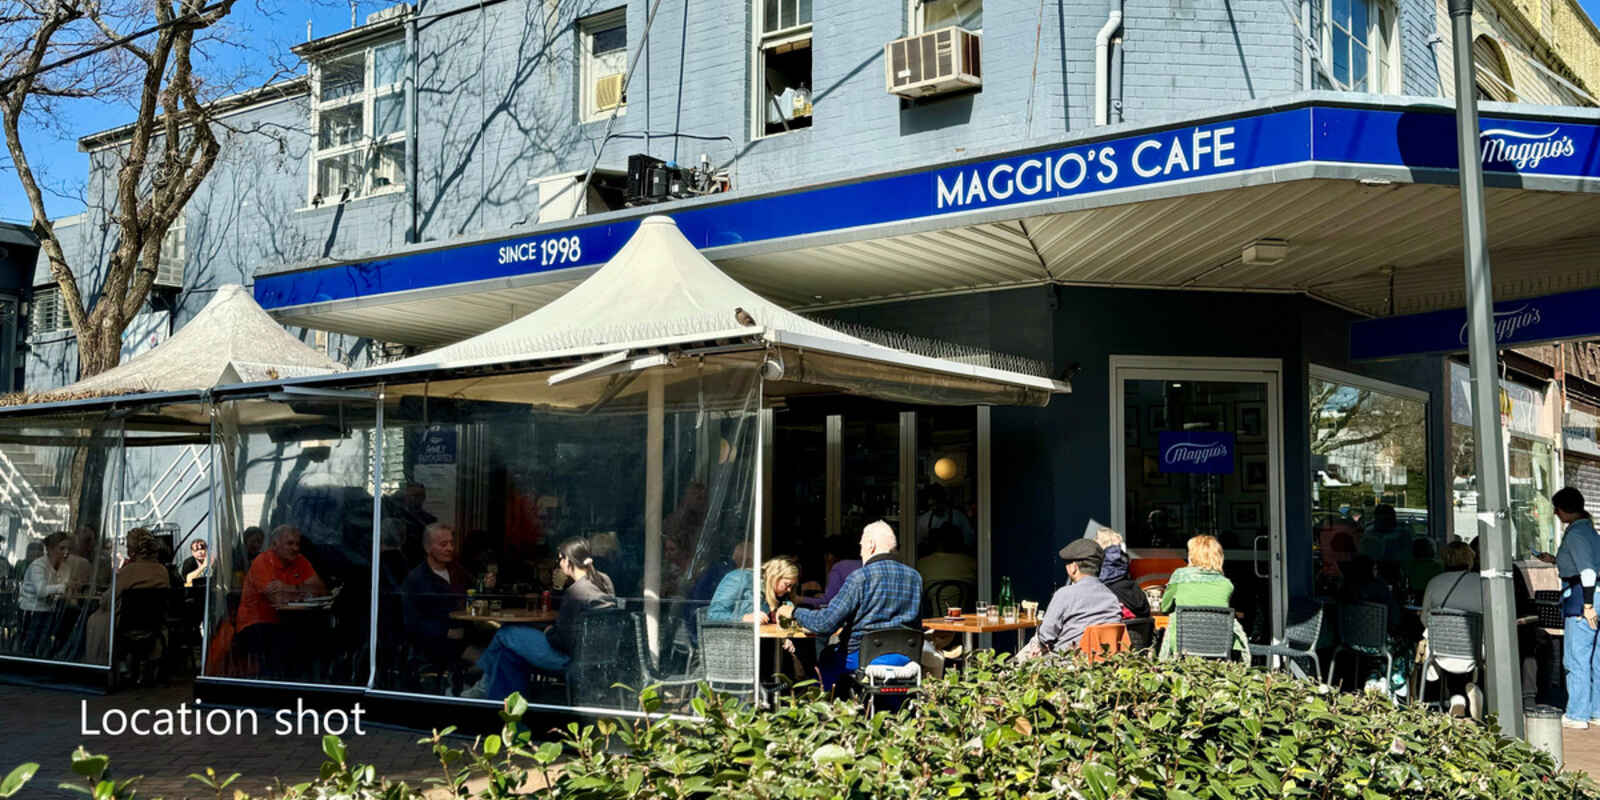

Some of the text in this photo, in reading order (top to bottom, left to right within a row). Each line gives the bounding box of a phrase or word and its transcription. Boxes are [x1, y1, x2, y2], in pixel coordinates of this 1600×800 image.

[1479, 127, 1575, 170] Maggio's
[936, 146, 1118, 209] MAGGIO'S
[498, 235, 581, 266] SINCE 1998
[1165, 441, 1228, 465] Maggio's
